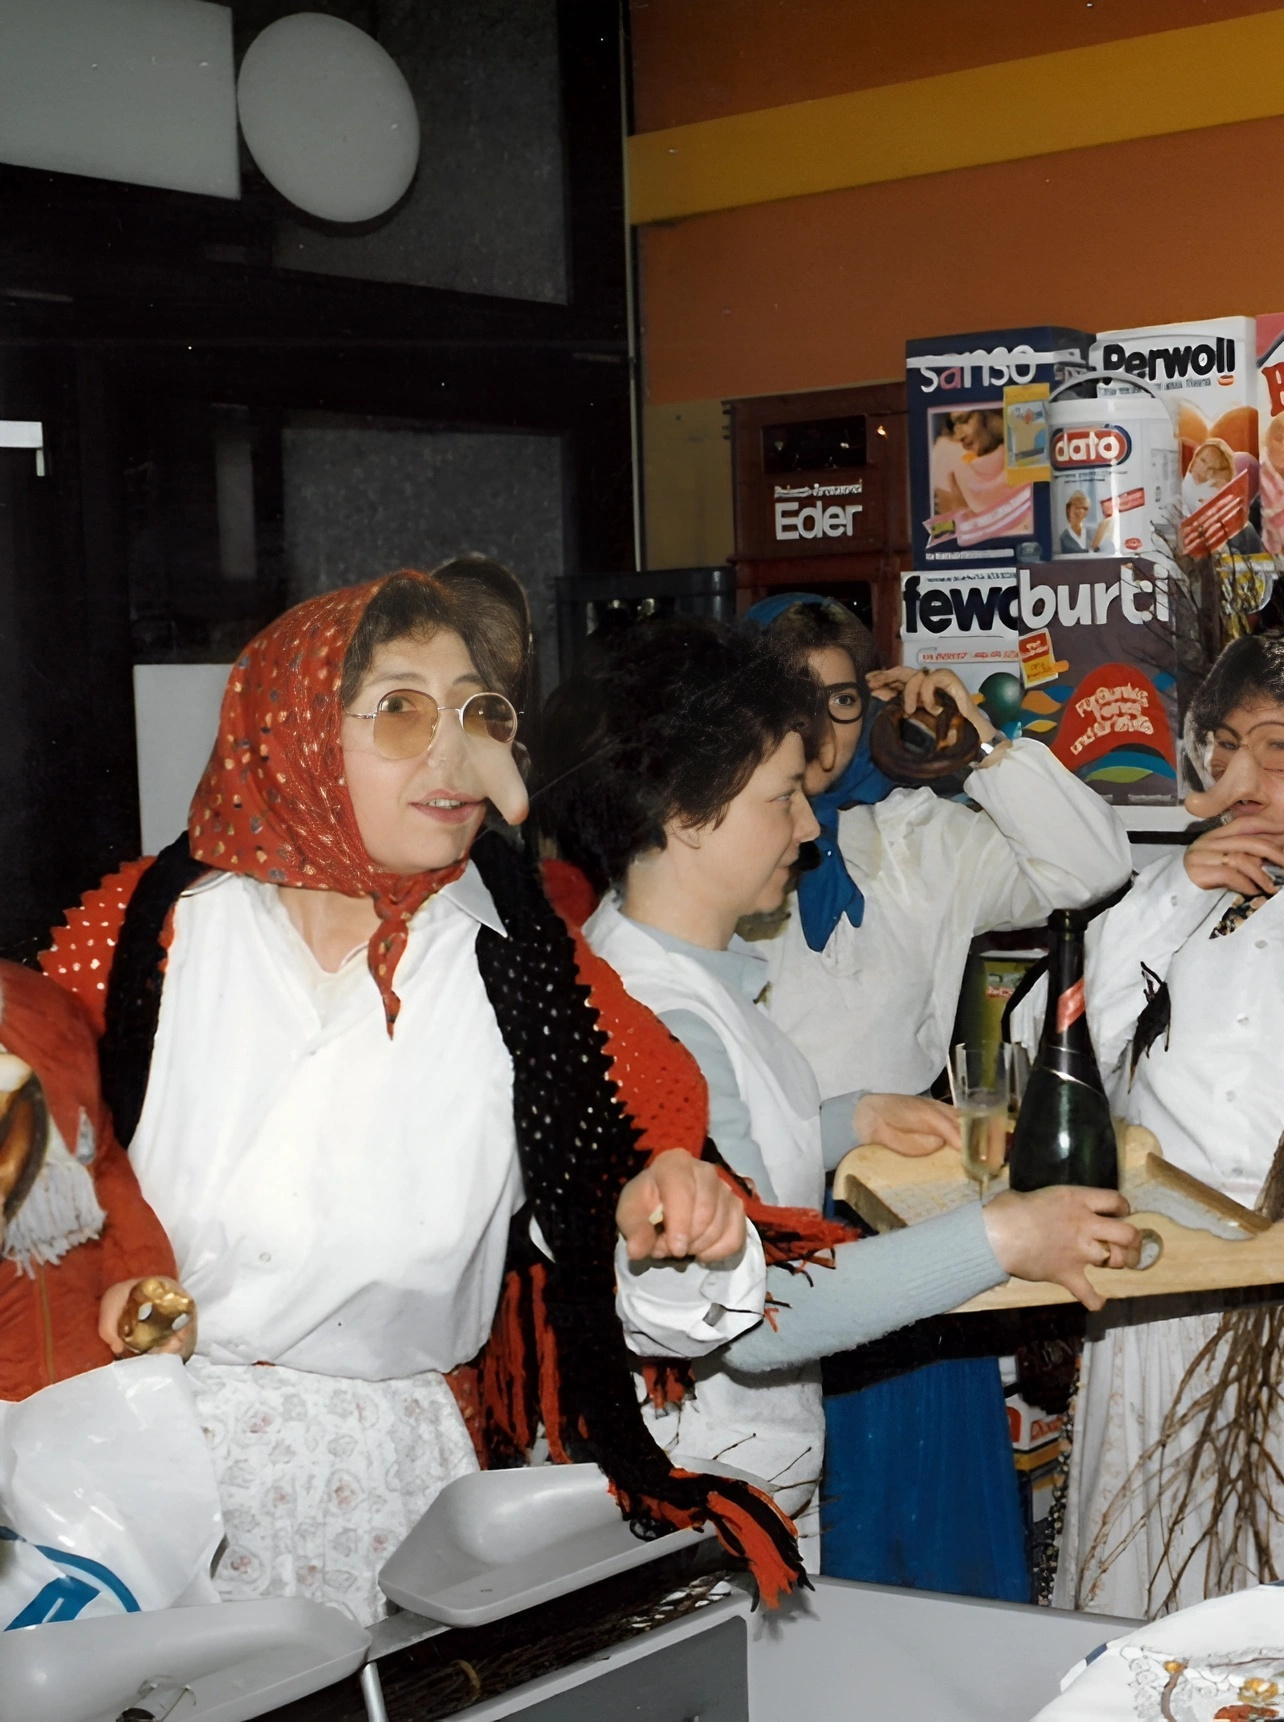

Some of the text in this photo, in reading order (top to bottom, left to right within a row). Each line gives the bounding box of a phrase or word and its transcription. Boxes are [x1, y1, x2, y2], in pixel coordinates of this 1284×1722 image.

[920, 345, 1037, 393] sanso
[1103, 337, 1235, 386] Perwoll
[1055, 430, 1120, 462] dato
[775, 500, 863, 540] Eder
[1019, 563, 1169, 629] burti
